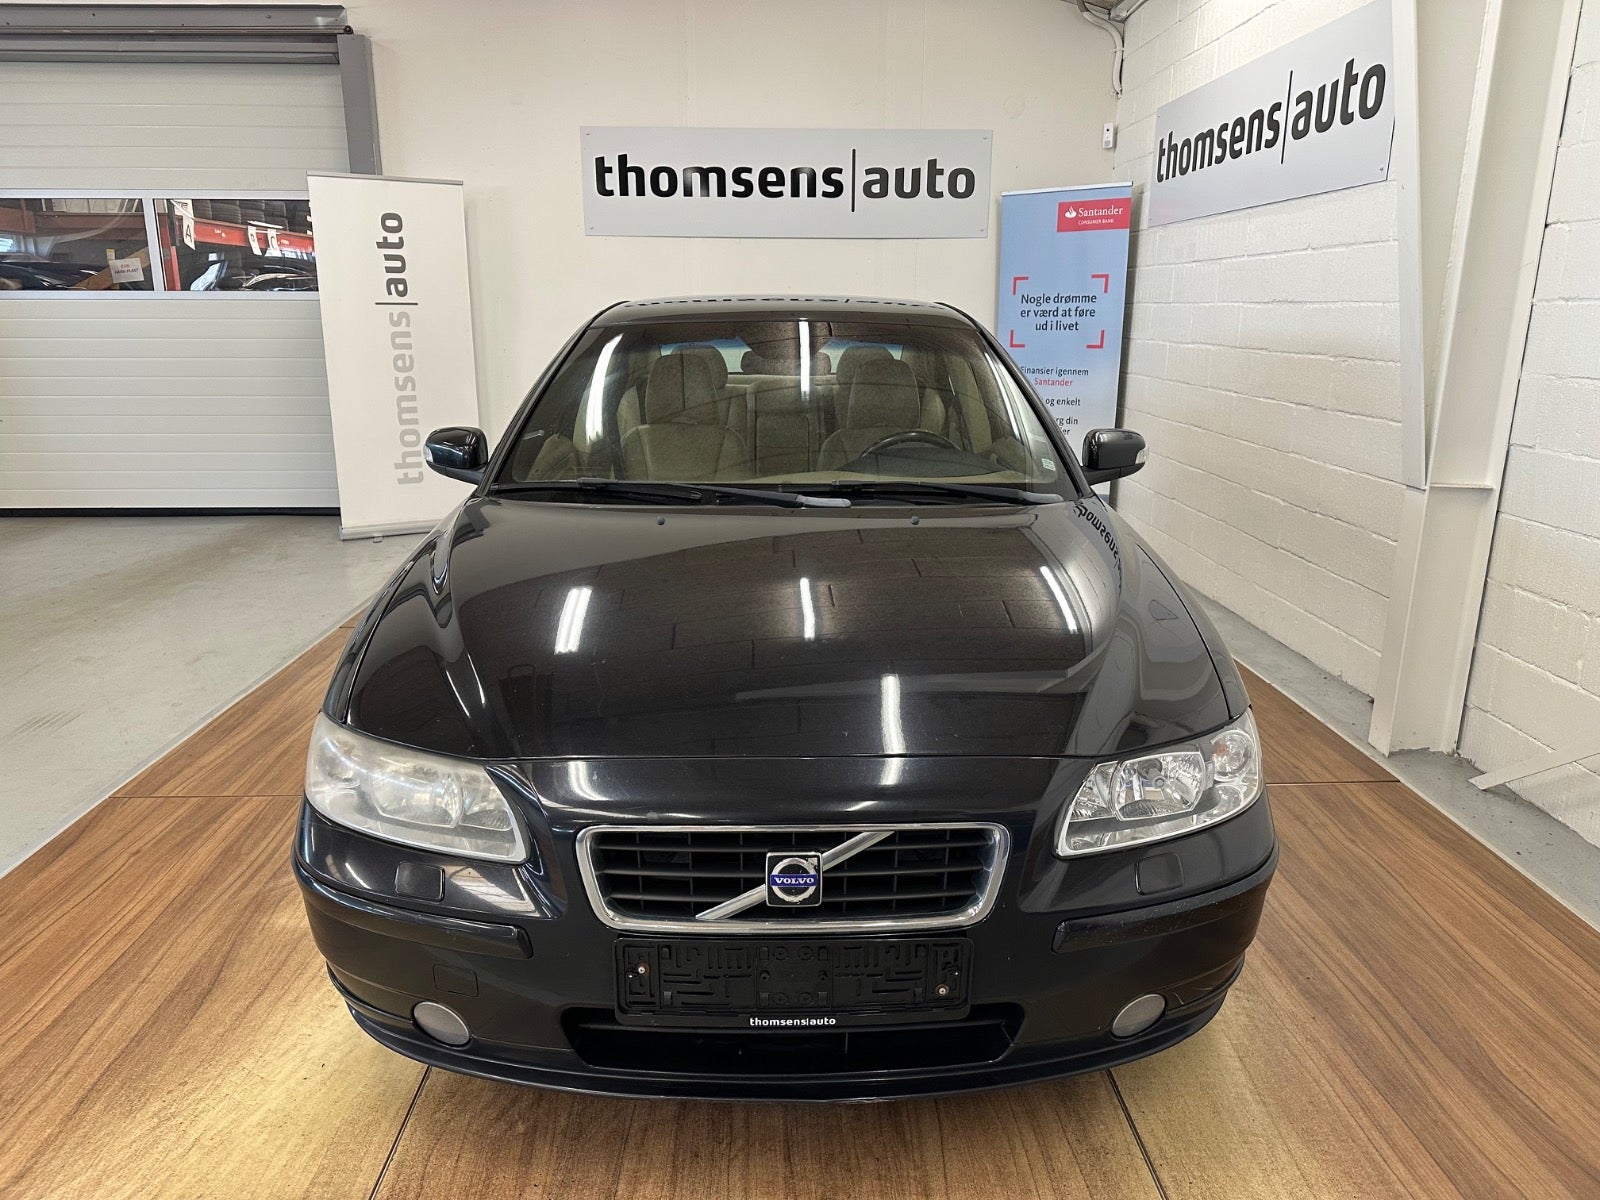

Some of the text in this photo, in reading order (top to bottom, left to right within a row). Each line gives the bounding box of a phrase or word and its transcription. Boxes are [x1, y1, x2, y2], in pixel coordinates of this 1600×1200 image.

[1078, 204, 1123, 217] Santander
[1021, 293, 1097, 307] Nogle drømme
[1020, 306, 1096, 318] er værd at føre
[1035, 320, 1048, 331] ud
[1055, 320, 1080, 331] livet
[1055, 366, 1089, 377] igennem
[1034, 378, 1073, 387] Santander
[1045, 397, 1081, 407] og enkelt
[1065, 416, 1079, 425] din
